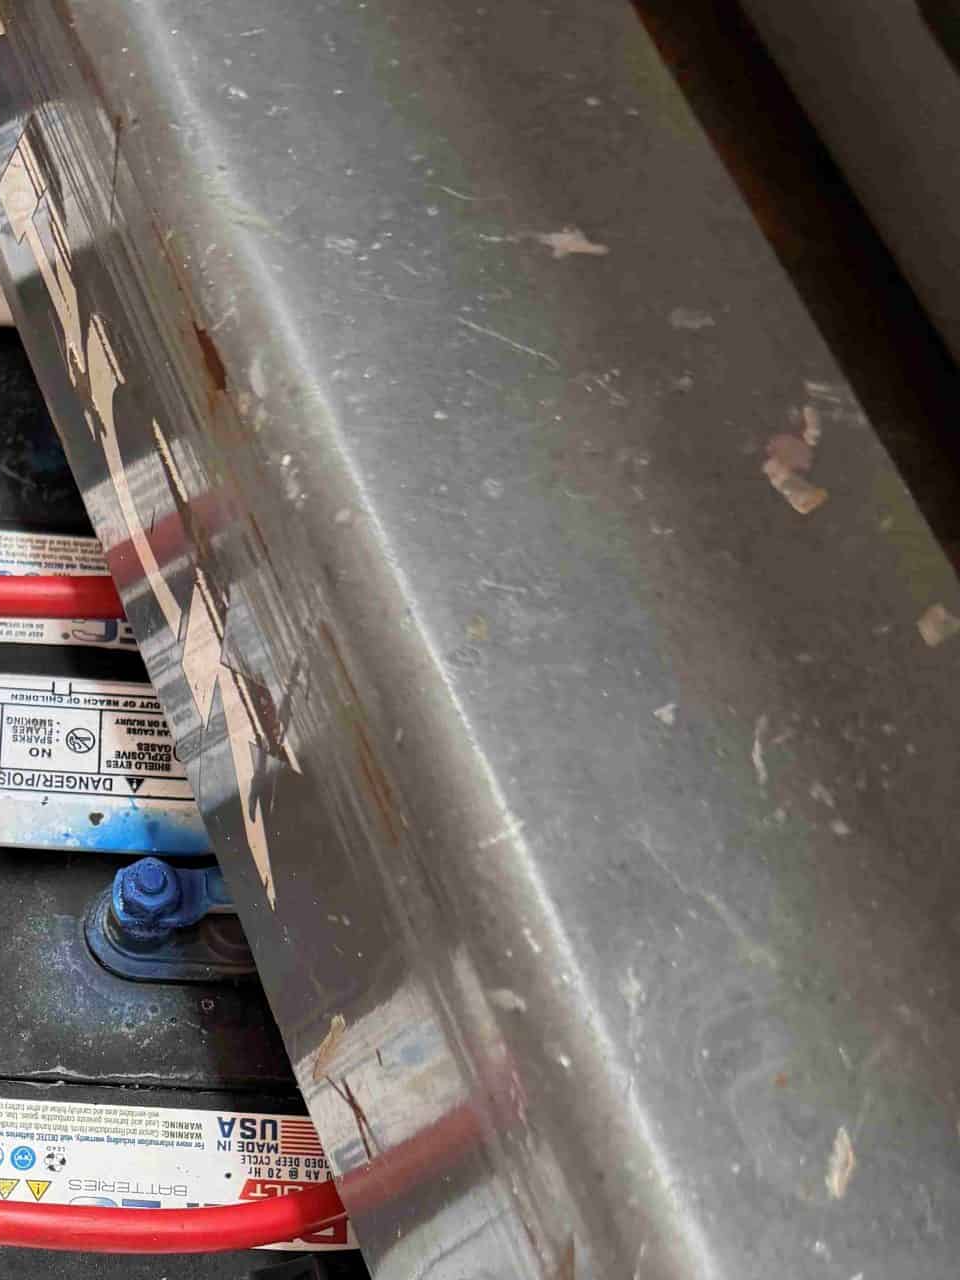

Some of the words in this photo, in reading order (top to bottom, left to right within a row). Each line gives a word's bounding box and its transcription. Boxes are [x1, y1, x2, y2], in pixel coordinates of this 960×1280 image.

[10, 693, 64, 704] CHILDREN
[6, 716, 54, 727] SMOKING
[12, 725, 53, 735] FLAMES
[126, 727, 155, 737] CAUSE
[12, 734, 53, 745] SPARKS
[28, 747, 52, 758] NO
[136, 742, 172, 753] GASES
[114, 750, 172, 762] EXPLOSIVE
[106, 759, 132, 770] EYES
[135, 760, 172, 772] SHIELD
[216, 1116, 279, 1141] USA
[216, 1140, 232, 1151] IN
[236, 1140, 279, 1154] MADE
[239, 1155, 271, 1166] CYCLE
[275, 1156, 300, 1168] DEEP
[247, 1166, 261, 1178] Hr
[267, 1167, 282, 1179] 20
[288, 1168, 299, 1179] @
[305, 1169, 320, 1180] Ah
[67, 1179, 188, 1198] BATTERIES
